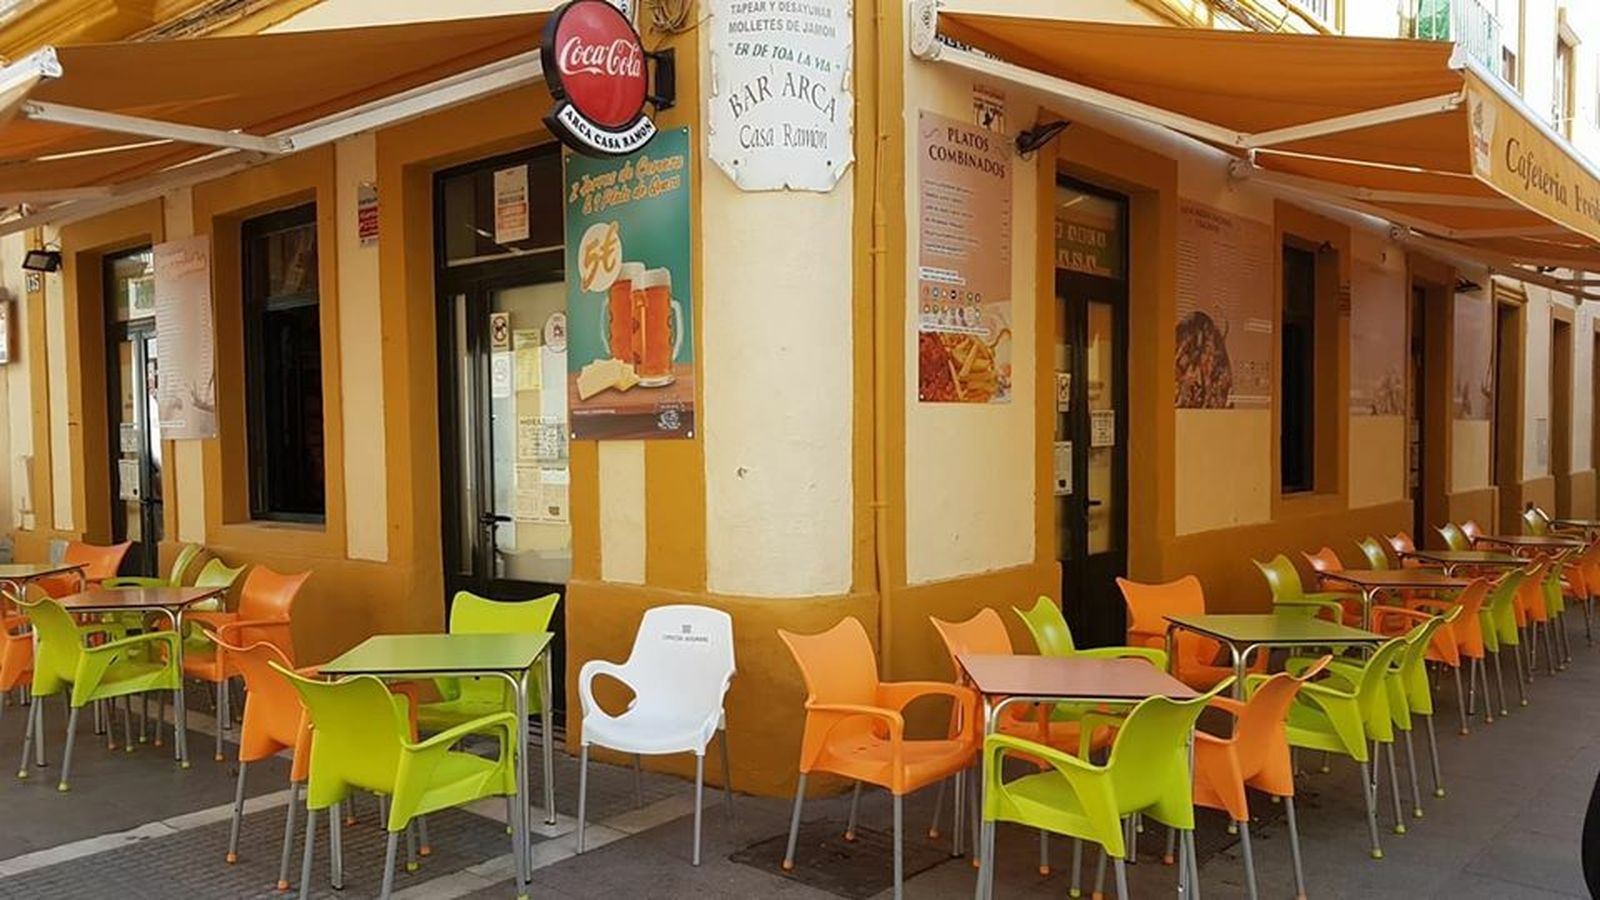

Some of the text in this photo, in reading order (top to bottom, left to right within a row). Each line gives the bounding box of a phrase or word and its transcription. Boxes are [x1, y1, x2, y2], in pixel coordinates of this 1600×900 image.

[730, 1, 832, 18] TAPEAR Y DESAYUNAR
[786, 20, 799, 32] DE
[560, 36, 640, 77] Coca-Cola
[752, 43, 768, 57] DE
[797, 52, 811, 67] LA
[728, 71, 836, 123] BAR ARCA
[565, 110, 592, 140] ARCA
[594, 133, 621, 149] CASA
[740, 124, 774, 149] Casa
[947, 127, 989, 153] PLATOS
[928, 144, 1006, 179] COMBINADOS
